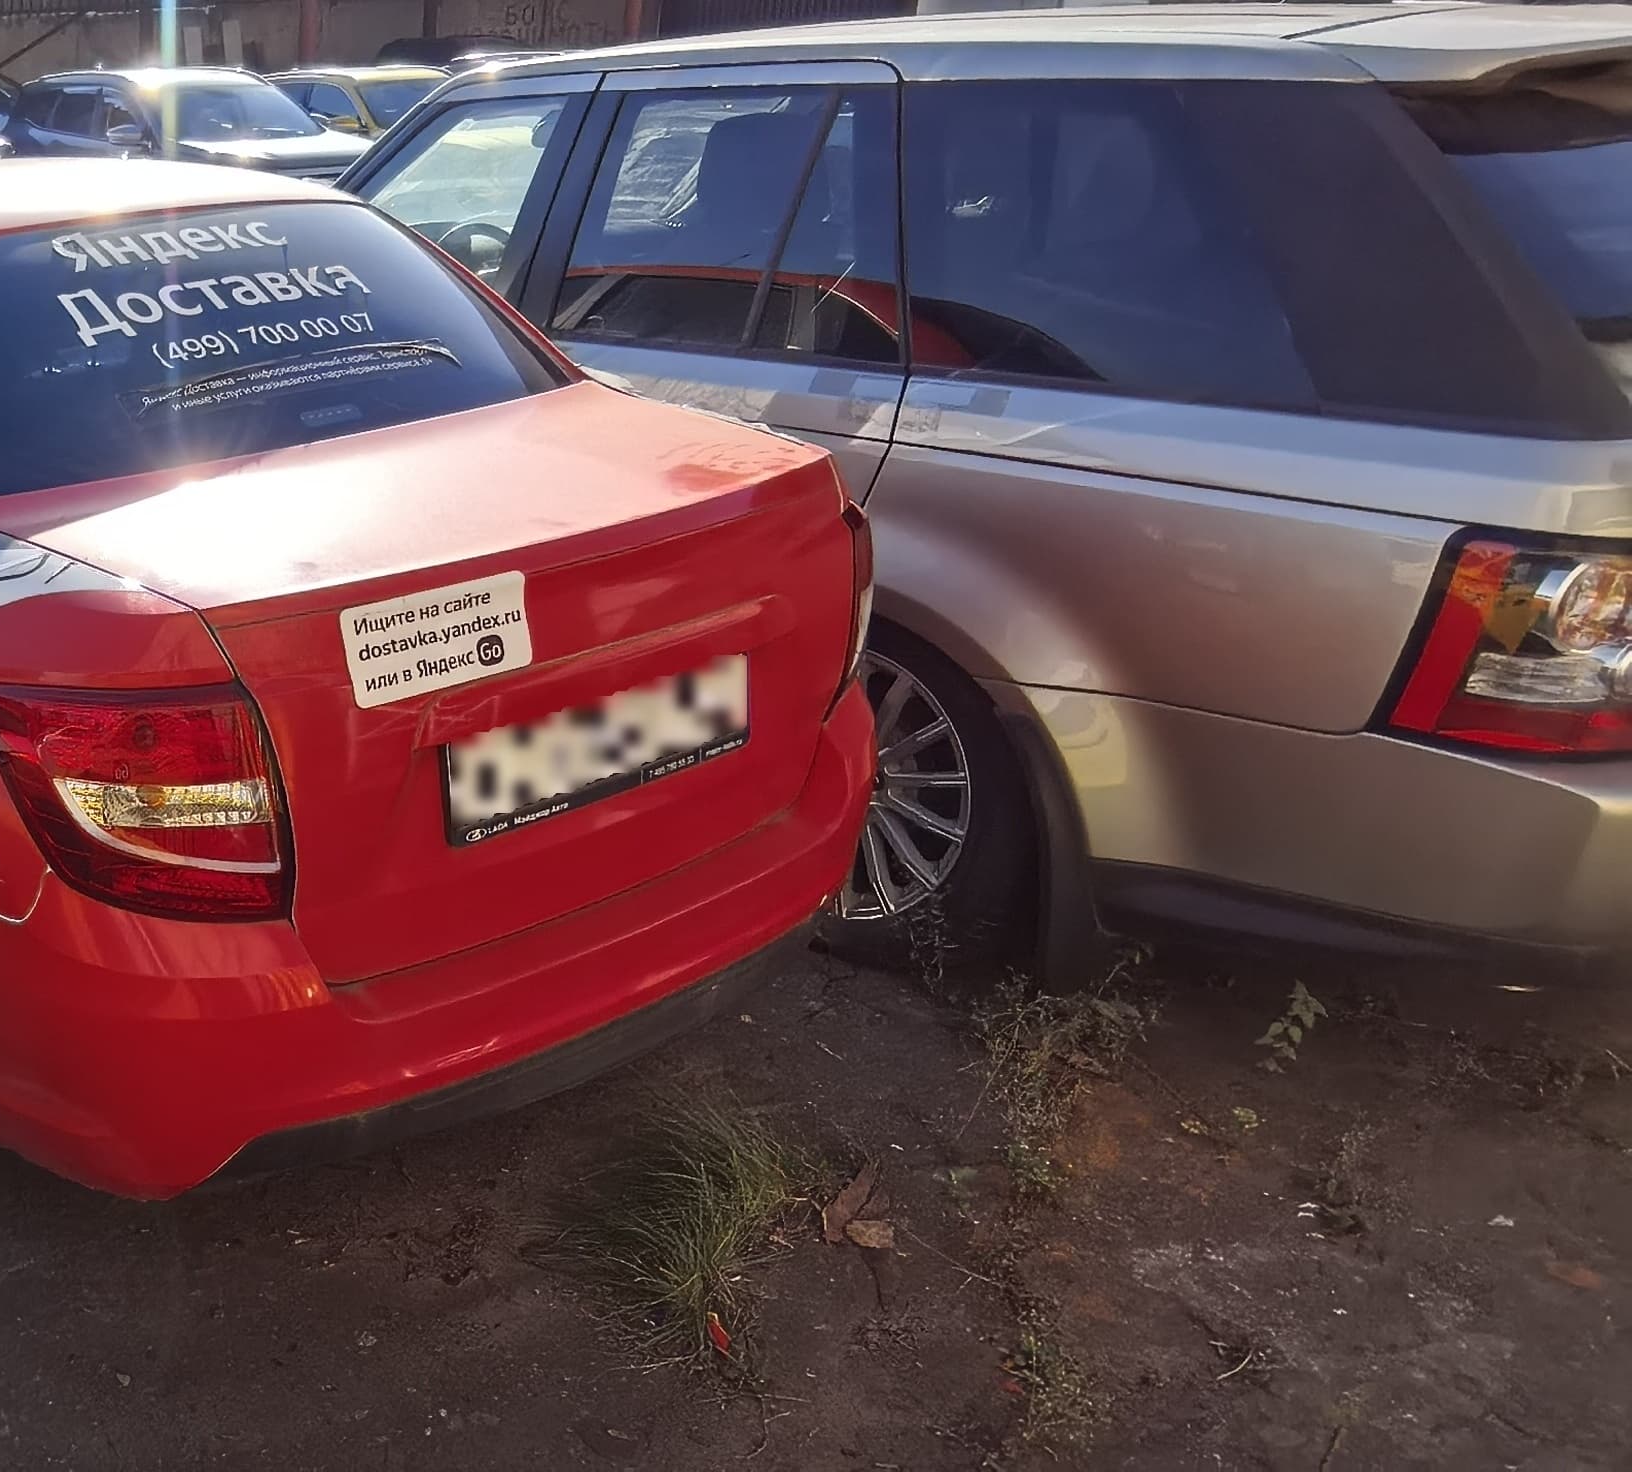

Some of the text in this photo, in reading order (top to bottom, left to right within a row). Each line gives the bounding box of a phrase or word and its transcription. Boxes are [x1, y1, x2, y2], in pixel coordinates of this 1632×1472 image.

[52, 222, 287, 272] Яндекс
[57, 265, 372, 348] Доставка
[151, 311, 374, 369] (499) 700 00 07
[182, 395, 213, 409] иные
[212, 387, 252, 403] услуги
[183, 377, 236, 397] Доставка
[353, 592, 491, 635] Ищите на сайте
[358, 609, 522, 662] dostavka.yandex.ru
[365, 640, 502, 693] или в Яндекс Go
